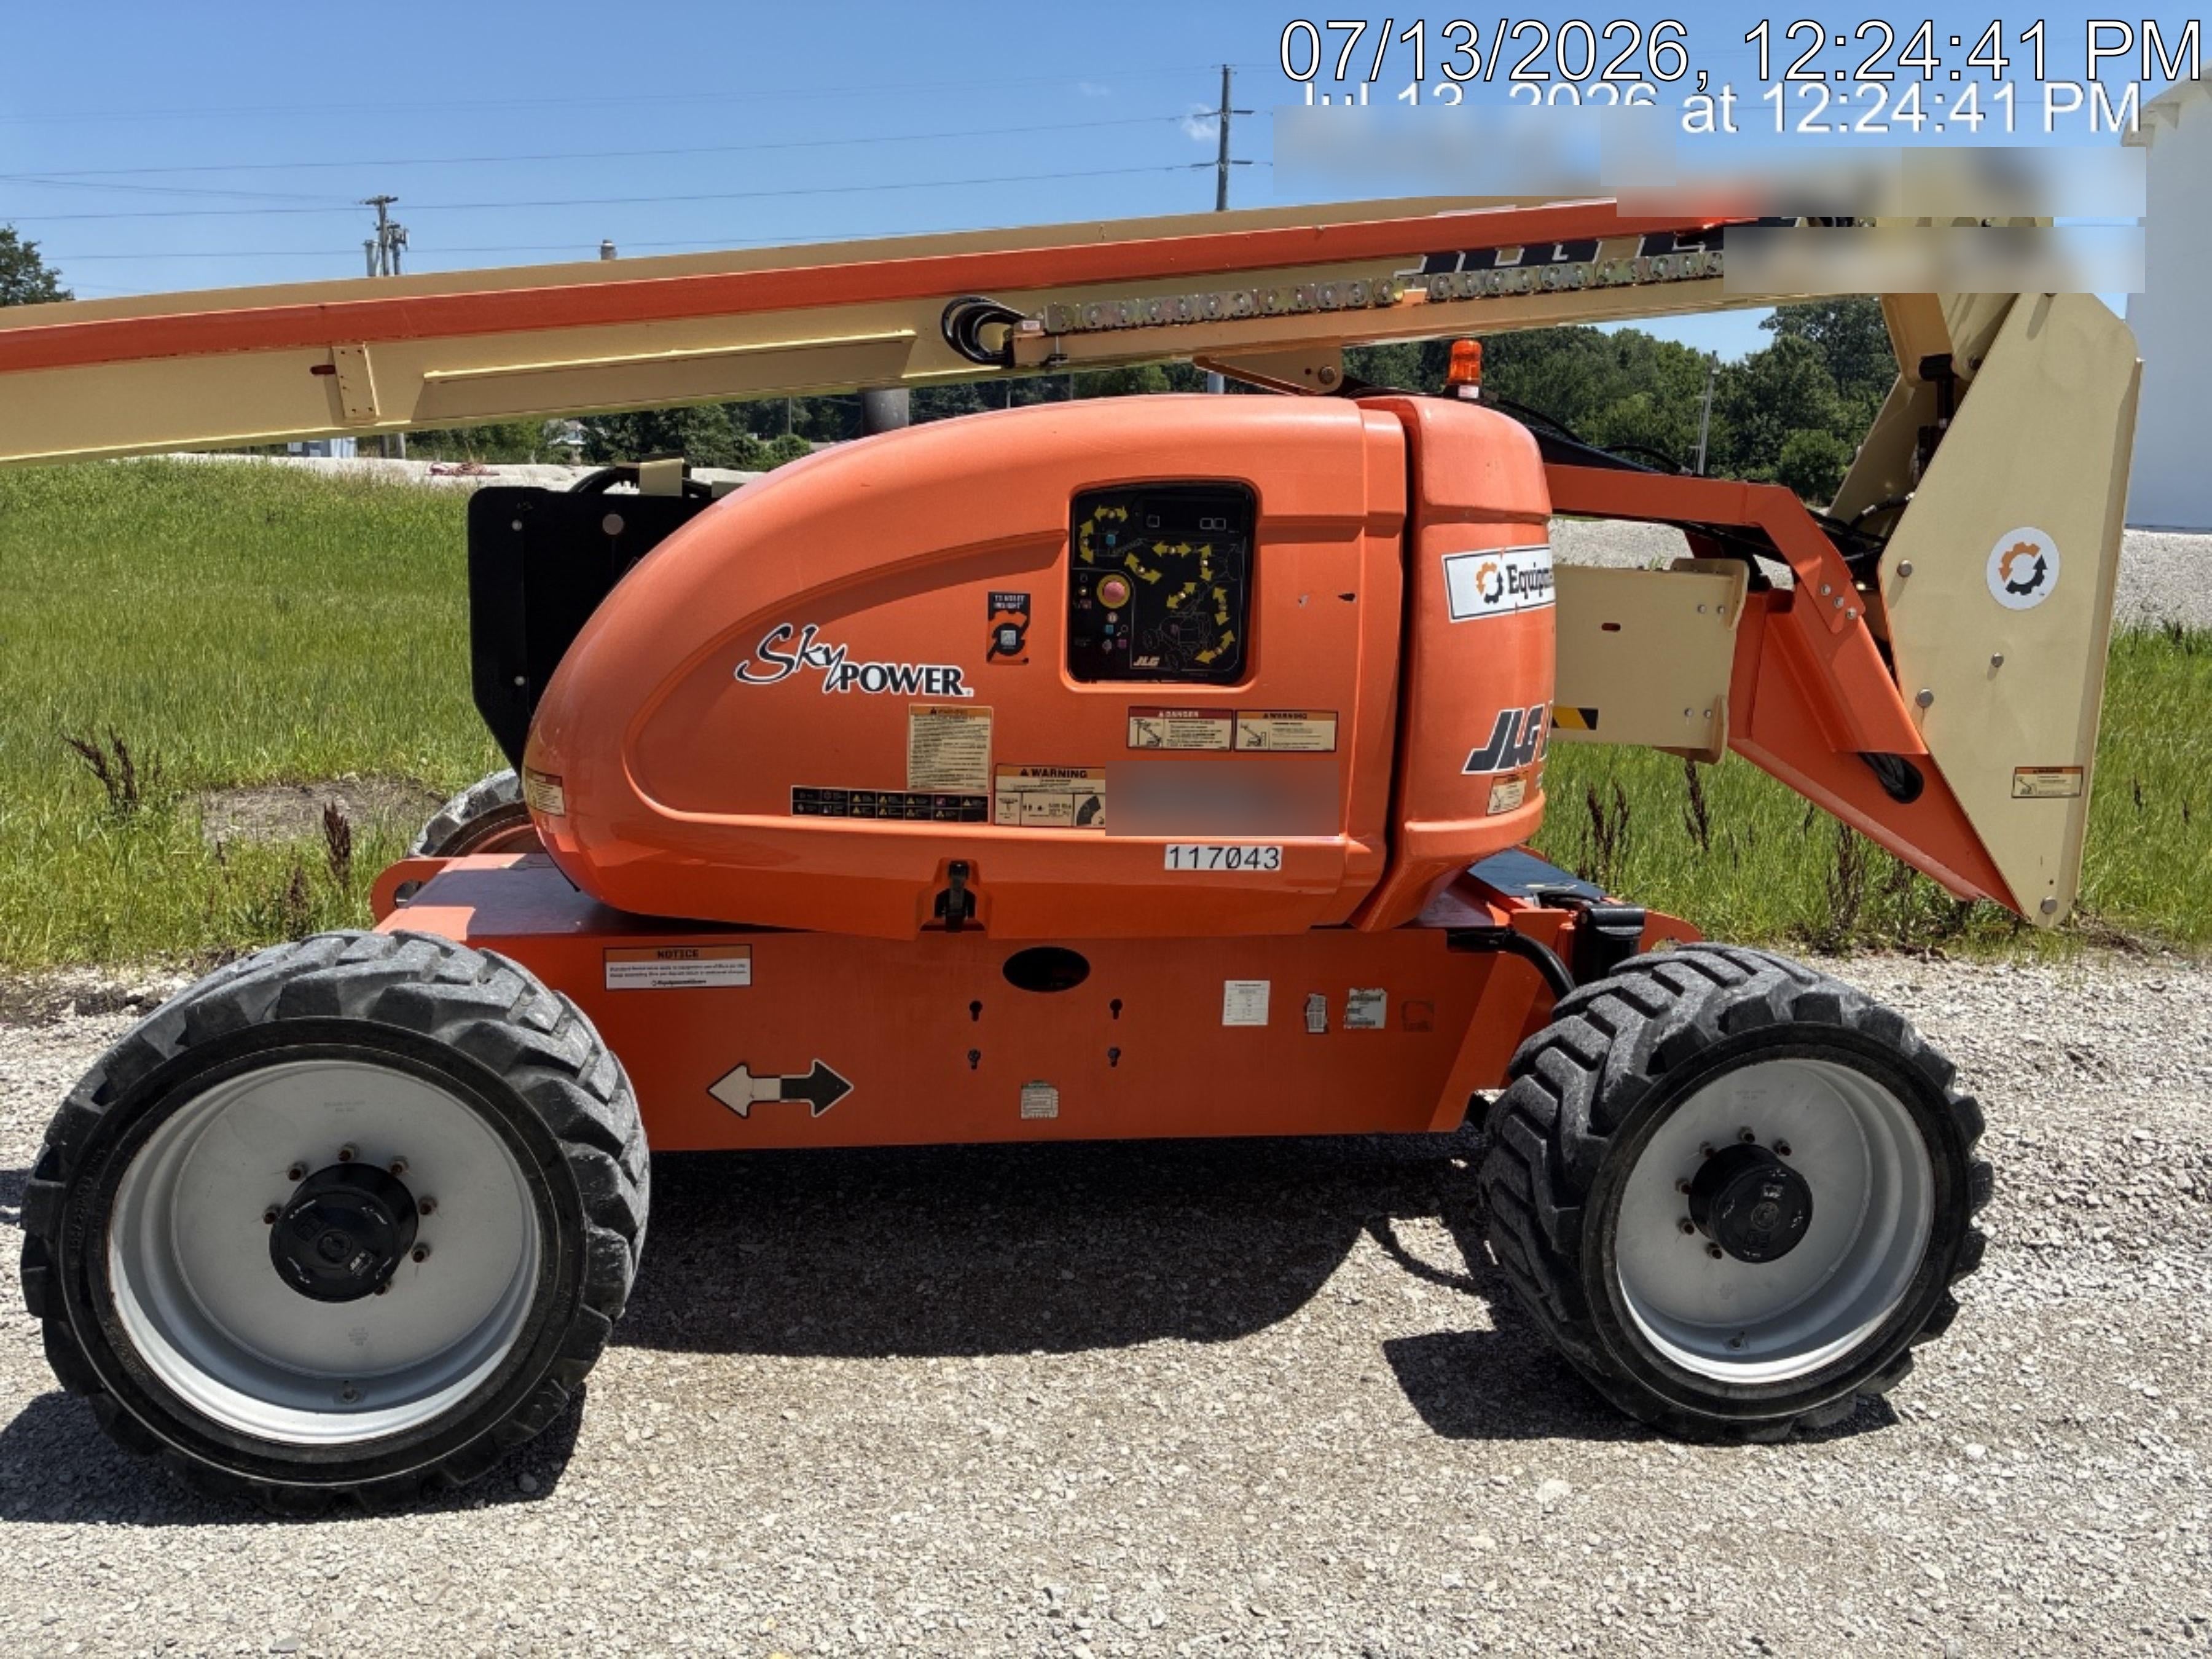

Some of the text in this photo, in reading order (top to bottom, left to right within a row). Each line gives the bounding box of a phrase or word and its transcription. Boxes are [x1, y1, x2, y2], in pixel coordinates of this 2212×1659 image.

[1133, 656, 1160, 667] JLG
[839, 663, 963, 697] POWER
[1462, 704, 1545, 775] JLG
[1032, 768, 1088, 779] WARNING
[1169, 845, 1280, 870] 117043
[657, 949, 699, 959] NOTICE
